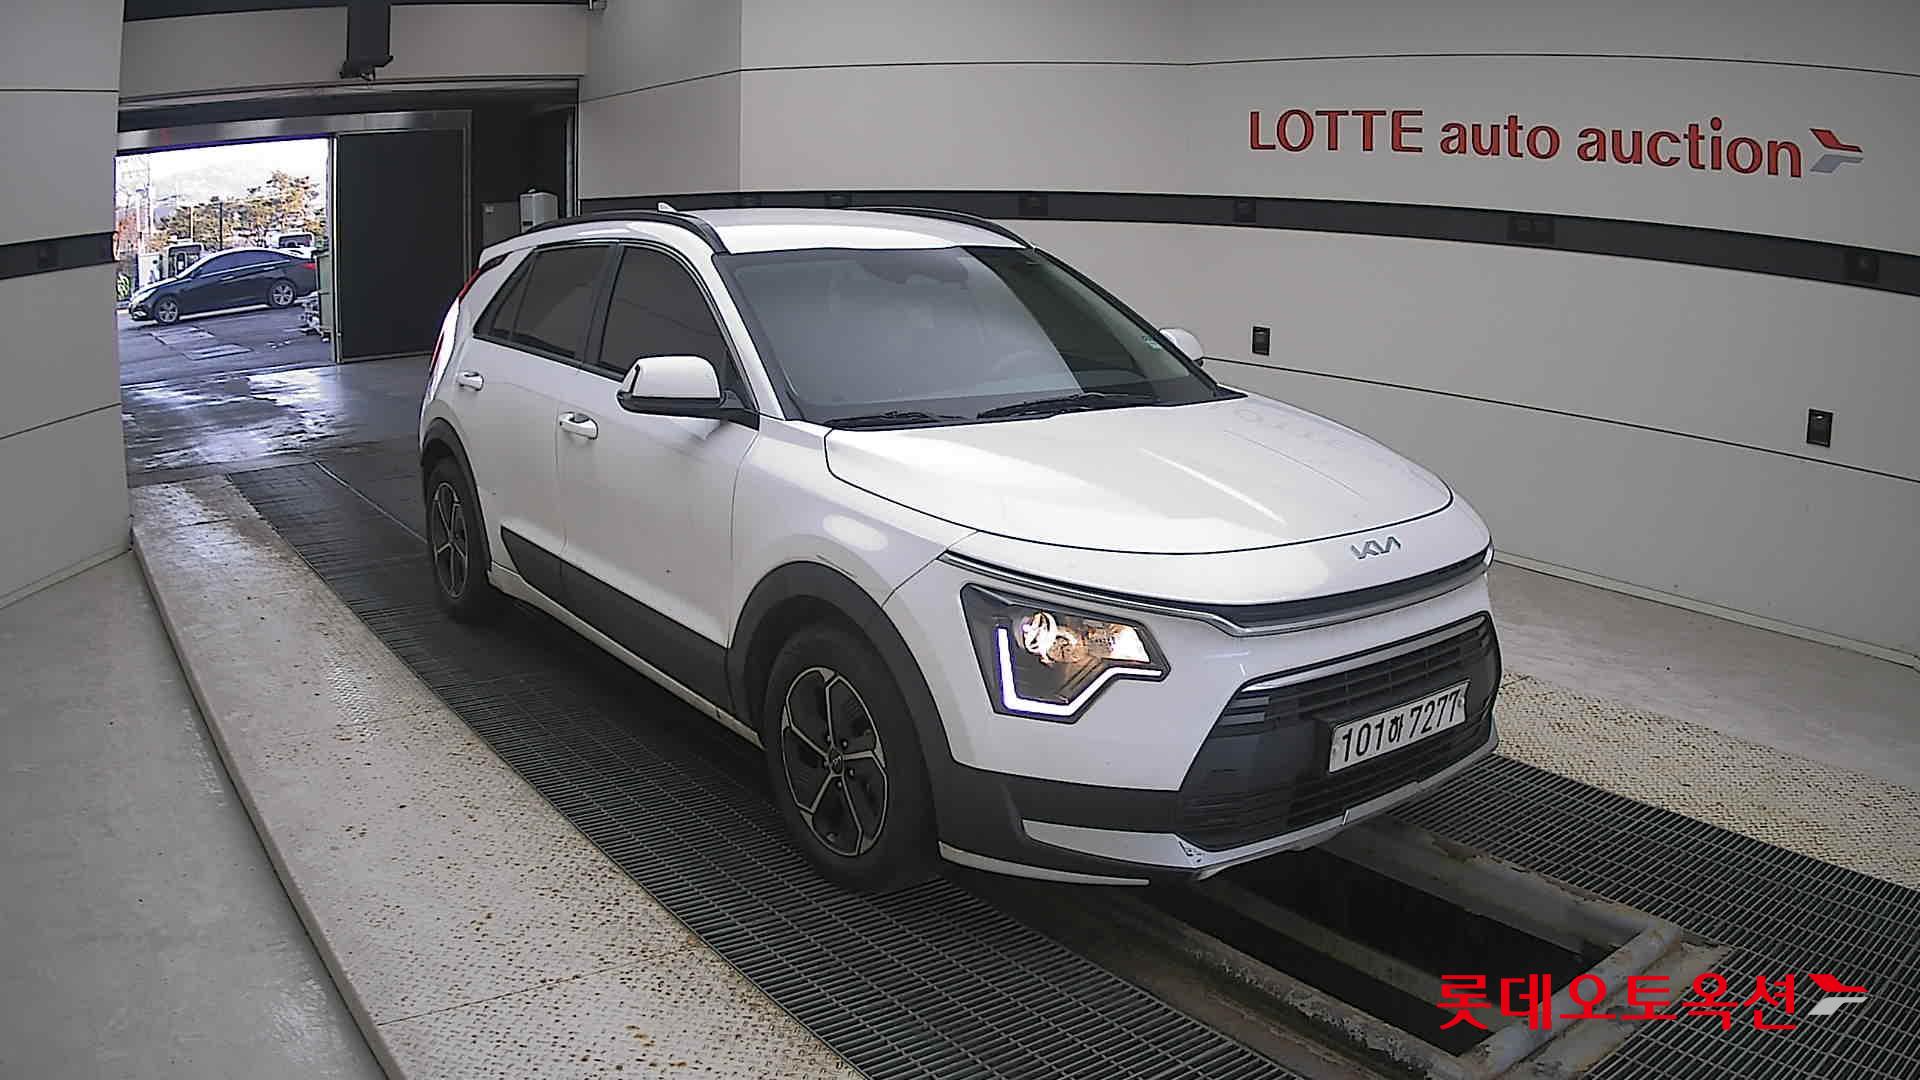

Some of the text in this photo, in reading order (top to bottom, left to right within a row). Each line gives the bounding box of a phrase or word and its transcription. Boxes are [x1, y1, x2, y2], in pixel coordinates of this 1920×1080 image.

[1248, 109, 1803, 178] LOTTE auto auction
[1409, 688, 1461, 738] 7277
